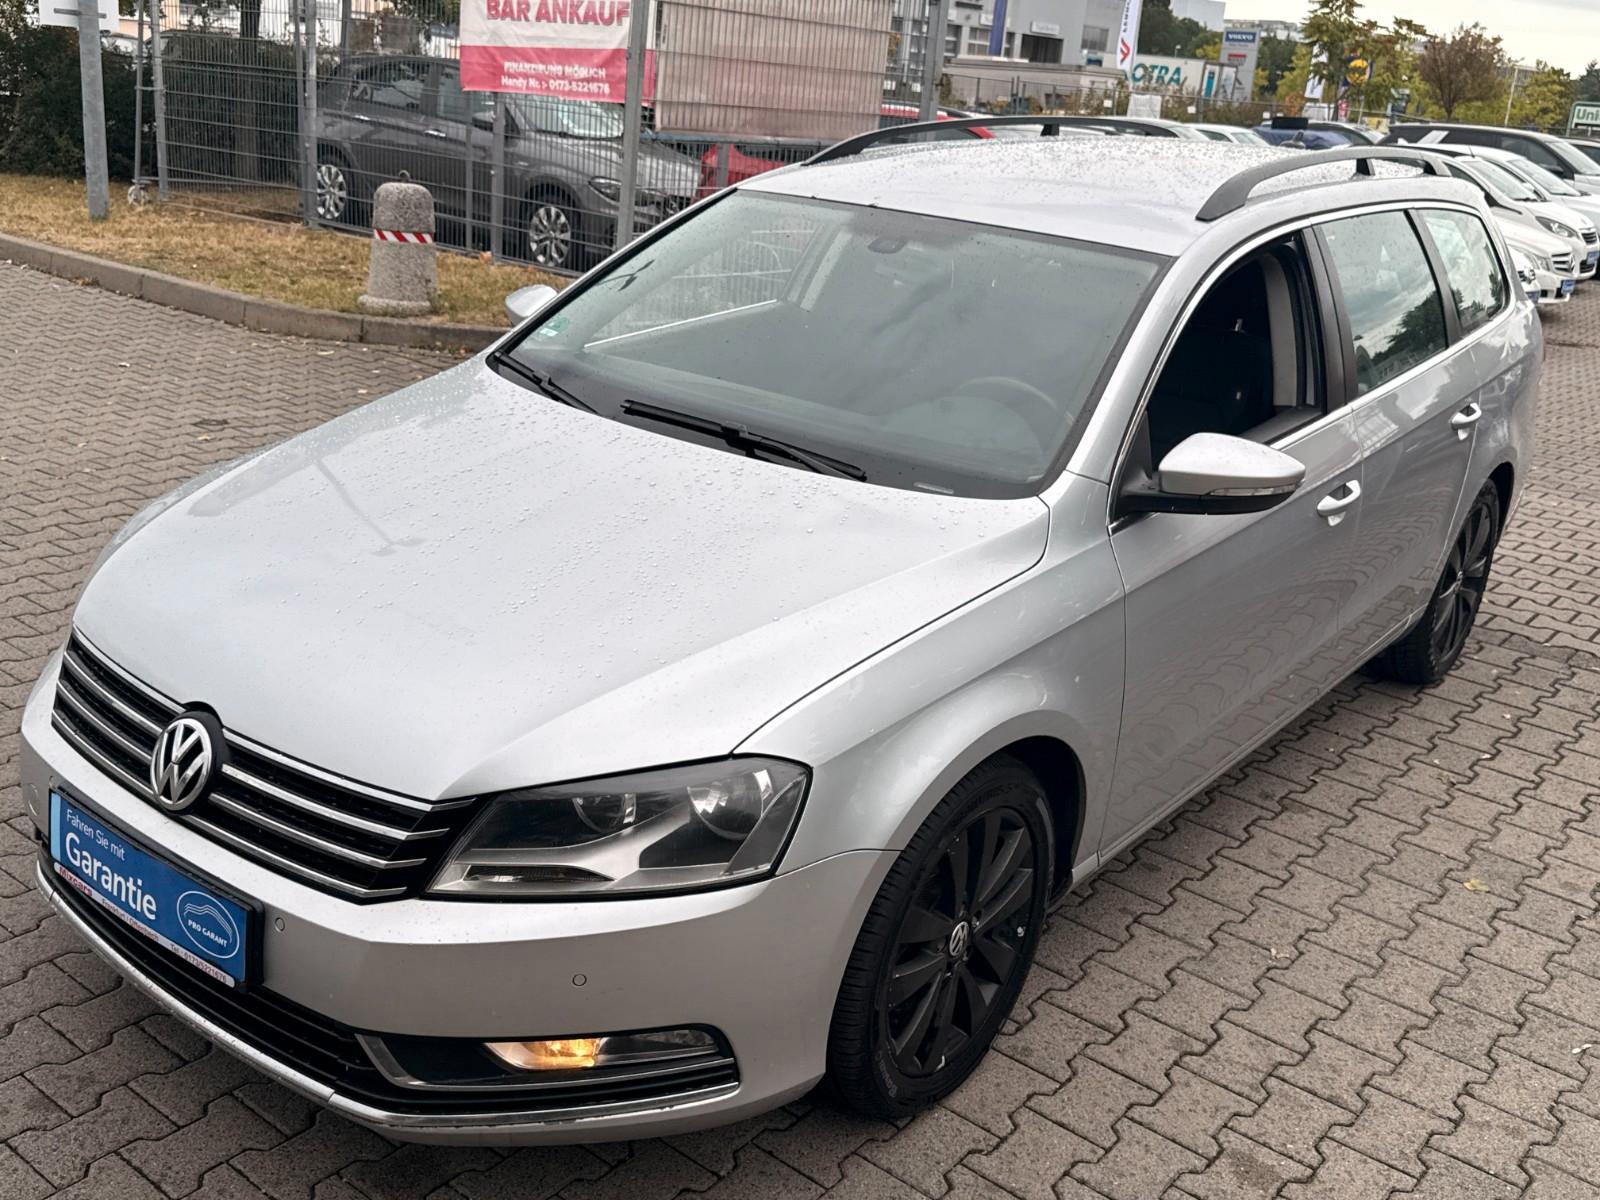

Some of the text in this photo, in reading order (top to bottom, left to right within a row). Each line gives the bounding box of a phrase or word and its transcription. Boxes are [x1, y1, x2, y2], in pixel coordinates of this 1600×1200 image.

[486, 0, 630, 26] BAR ANKAUF
[501, 75, 527, 91] Handy
[66, 808, 126, 861] Fahren Sie mit
[65, 832, 158, 921] Garantie
[187, 919, 228, 948] PRO GARANT
